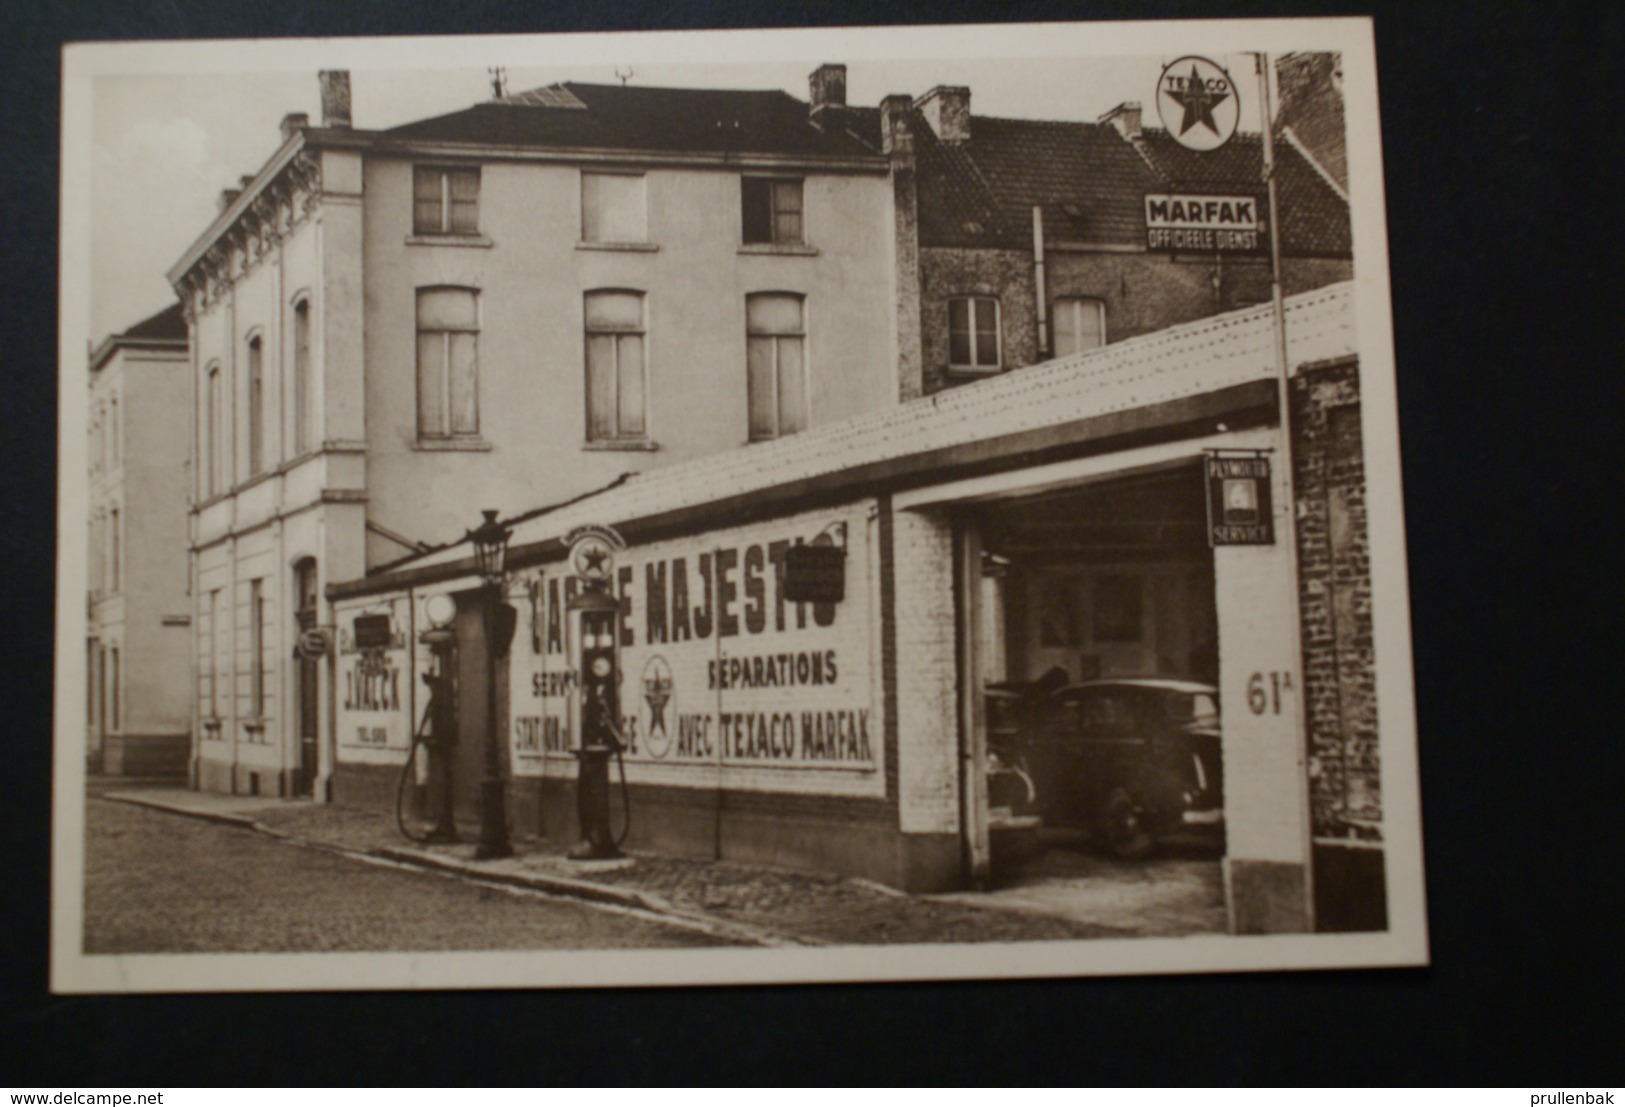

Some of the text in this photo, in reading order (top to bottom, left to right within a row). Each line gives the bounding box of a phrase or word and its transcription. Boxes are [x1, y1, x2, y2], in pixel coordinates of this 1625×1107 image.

[1148, 200, 1253, 224] MARFAK
[676, 712, 713, 758] AVEC
[719, 711, 795, 759] TEXACO
[801, 708, 873, 761] MARFAK
